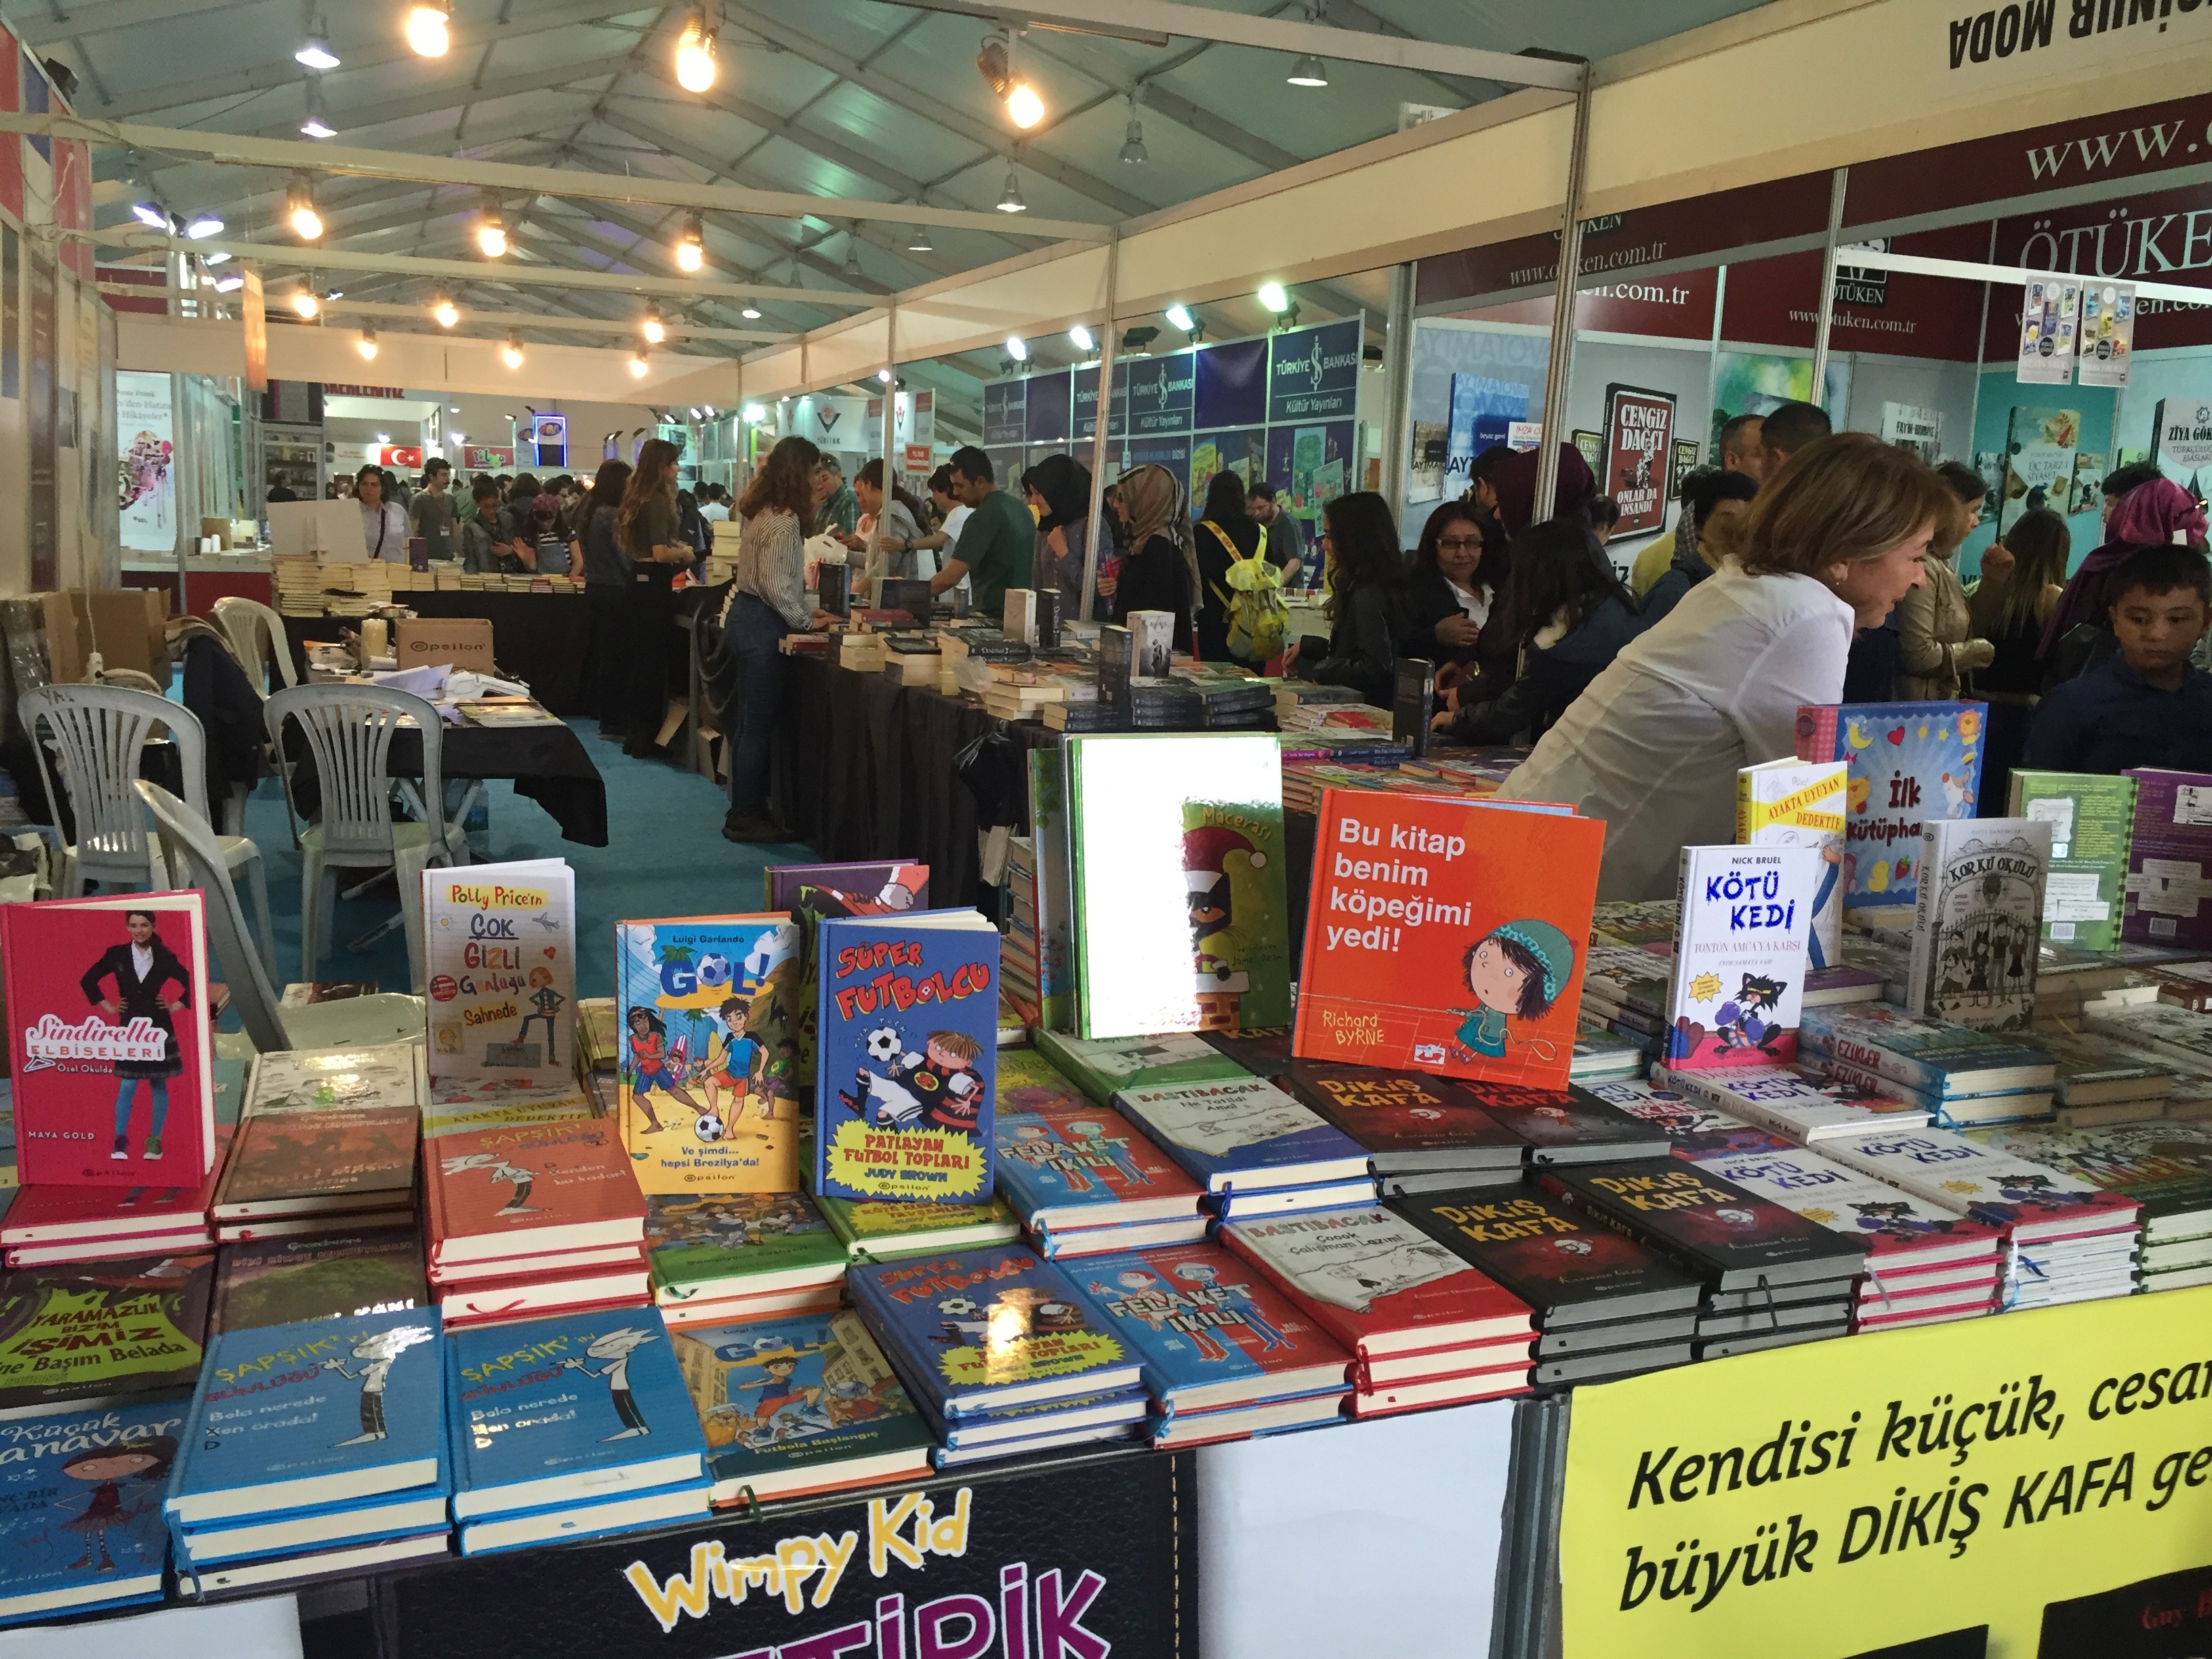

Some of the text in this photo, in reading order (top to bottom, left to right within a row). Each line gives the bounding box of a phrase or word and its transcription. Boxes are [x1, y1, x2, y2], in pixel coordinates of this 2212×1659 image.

[1949, 0, 2055, 70] MODA
[2026, 120, 2212, 181] www.
[1276, 359, 1311, 376] TÜRKİYE
[1286, 401, 1309, 413] Kültür
[1620, 404, 1668, 430] CENGİZ
[2169, 425, 2190, 441] ZİYA
[1617, 487, 1658, 504] ONLAR DA
[1769, 777, 1841, 820] AYAKTA UYUYAN
[1888, 770, 1921, 808] İlk
[1796, 811, 1841, 830] DEDEKTİF
[1338, 818, 1467, 862] Bu kitap
[1334, 852, 1429, 887] benim
[1732, 856, 1782, 865] NICK BRUEL
[1949, 856, 1996, 883] KORKU
[1997, 857, 2037, 879] OKULU
[452, 884, 489, 912] Polly
[1705, 871, 1780, 907] KÖTÜ
[1330, 886, 1473, 927] köpeğimi
[1729, 899, 1796, 935] KEDİ
[470, 913, 516, 941] ÇOK
[672, 935, 745, 945] Luigi Garlando
[1326, 924, 1401, 953] yedi!
[836, 940, 924, 979] SÜPER
[834, 962, 991, 1023] FUTBOLCU
[464, 1001, 518, 1027] Sahnede
[1322, 1008, 1378, 1029] Richard
[29, 1017, 163, 1044] Sindirella
[1334, 1027, 1385, 1046] BYRNE
[30, 1044, 161, 1058] ELBİSELERİ
[57, 1062, 113, 1073] Özel Okulda
[1137, 1084, 1267, 1102] BASTIBACAK
[1332, 1092, 1443, 1107] KAFA
[28, 1131, 95, 1140] MAYA GOLD
[865, 1134, 945, 1153] PATLAYAN
[995, 1136, 1130, 1160] FELAKET
[1853, 1137, 1940, 1158] KÖTÜ
[660, 1157, 760, 1169] hepsi Brezilya'da!
[681, 1146, 695, 1155] Ve
[844, 1148, 970, 1170] FUTBOL TOPLARI
[864, 1167, 948, 1183] JUDY BROWN
[1589, 1172, 1704, 1195] DİKİŞ
[1715, 1161, 1805, 1183] KÖTÜ
[1767, 1168, 1853, 1191] KEDİ
[1431, 1199, 1549, 1225] DİKİŞ
[1620, 1187, 1738, 1211] KAFA
[1246, 1212, 1392, 1239] BASTIBACAK
[1458, 1216, 1580, 1243] KAFA
[1289, 1240, 1355, 1255] Çalışmam
[1104, 1283, 1254, 1318] FELAKET
[30, 1301, 161, 1328] YARAMAZLIK
[32, 1341, 188, 1373] Başım Belada
[259, 1395, 327, 1414] nerede
[470, 1393, 578, 1421] Bela nerede
[0, 1417, 182, 1465] anavar
[754, 1439, 810, 1455] Futbola
[1627, 1373, 2065, 1511] Kendisi küçük,
[1618, 1515, 1820, 1614] büyük
[1837, 1475, 1990, 1561] DİKİŞ
[2002, 1450, 2136, 1530] KAFA
[623, 1487, 973, 1634] Wimpy Kid
